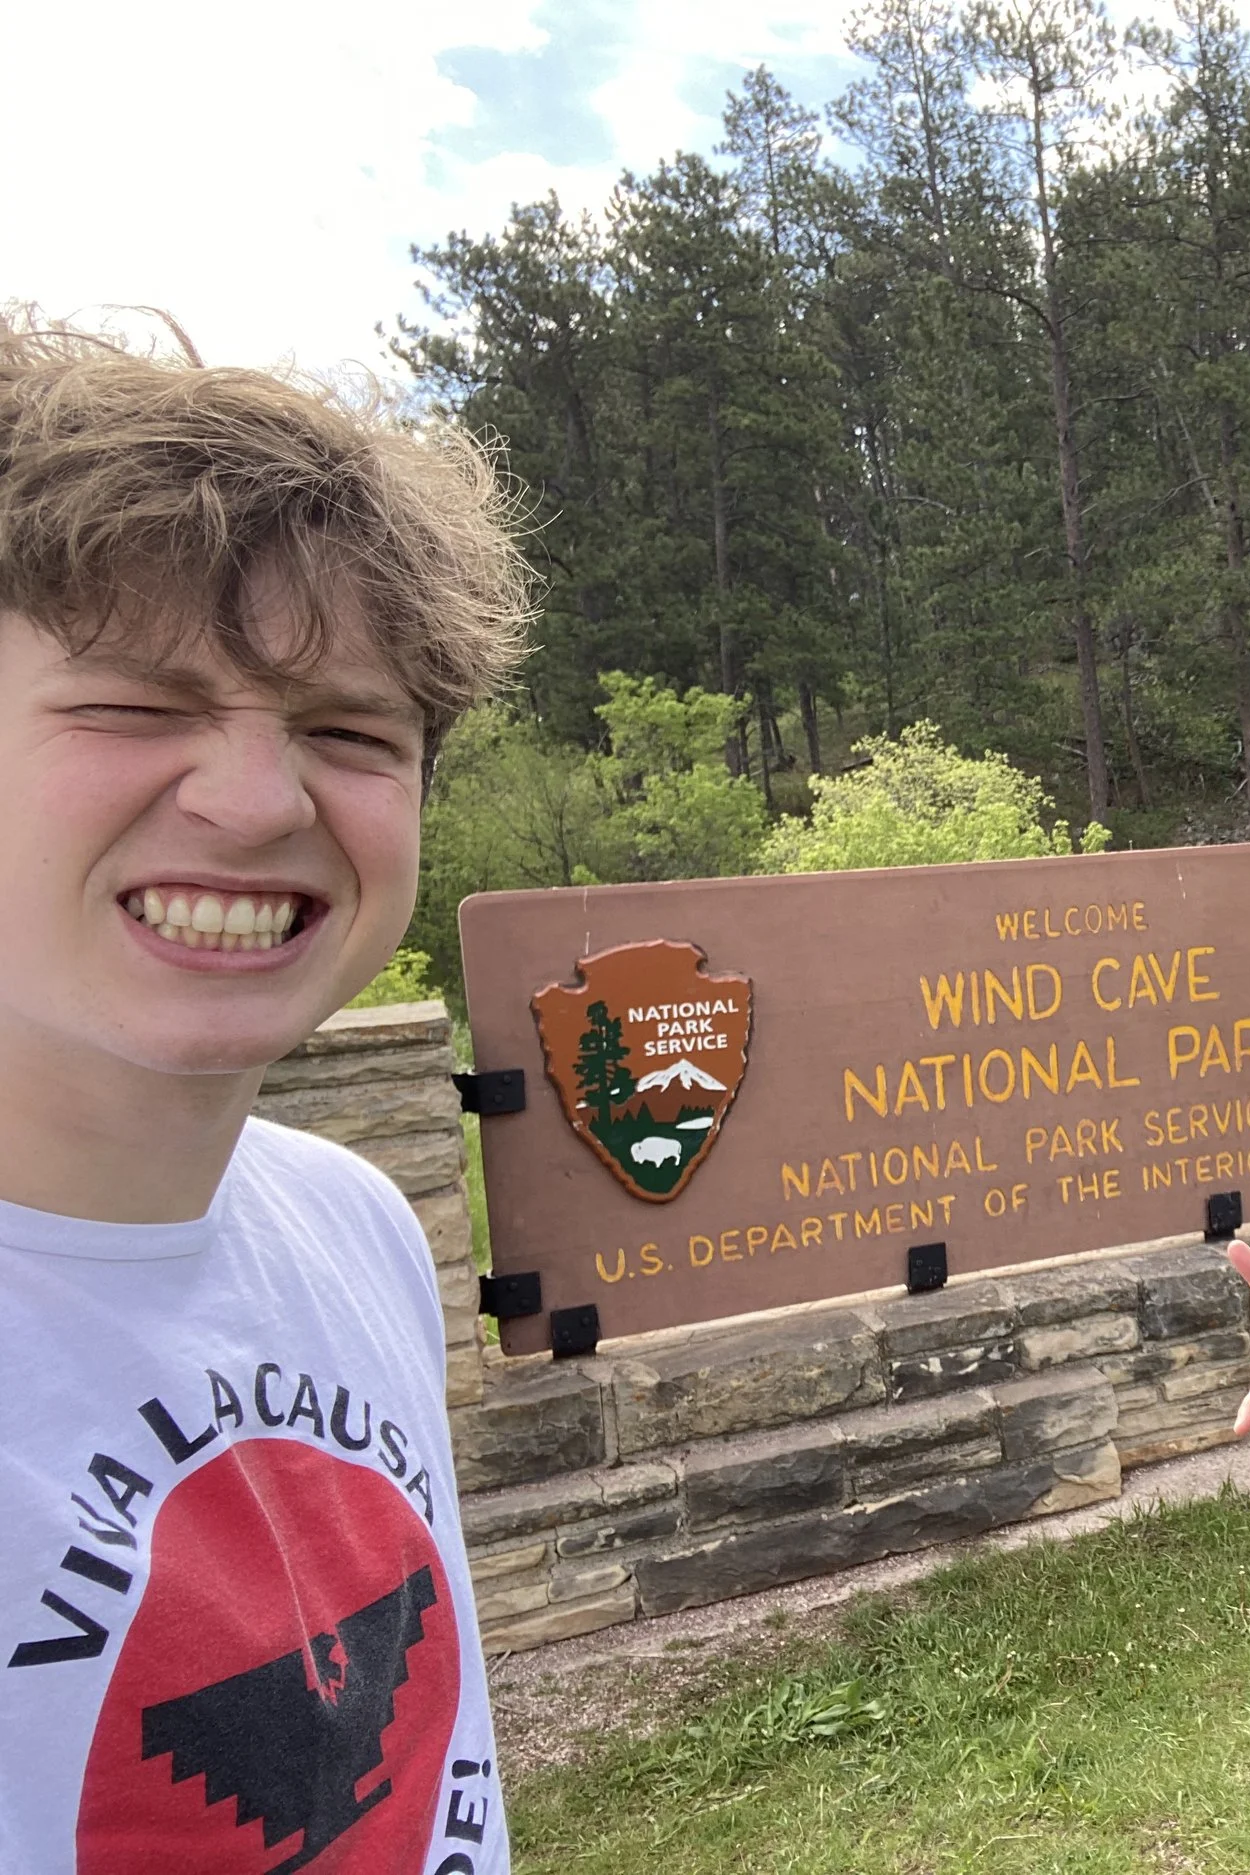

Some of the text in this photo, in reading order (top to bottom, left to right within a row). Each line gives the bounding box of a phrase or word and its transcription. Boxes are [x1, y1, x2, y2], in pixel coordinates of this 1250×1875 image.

[995, 902, 1148, 942] WELCOME
[628, 998, 739, 1023] NATIONAL
[657, 1018, 713, 1037] PARK
[919, 946, 1220, 1030] WIND CAVE
[644, 1034, 728, 1056] SERVICE
[843, 1036, 1141, 1122] NATIONAL
[781, 1136, 998, 1200] NATIONAL
[1024, 1117, 1124, 1165] PARK
[596, 1243, 673, 1283] U.S.
[688, 1195, 956, 1268] DEPARTMENT
[984, 1183, 1030, 1217] OF
[1056, 1168, 1122, 1203] THE
[7, 1452, 153, 1668] VIVA
